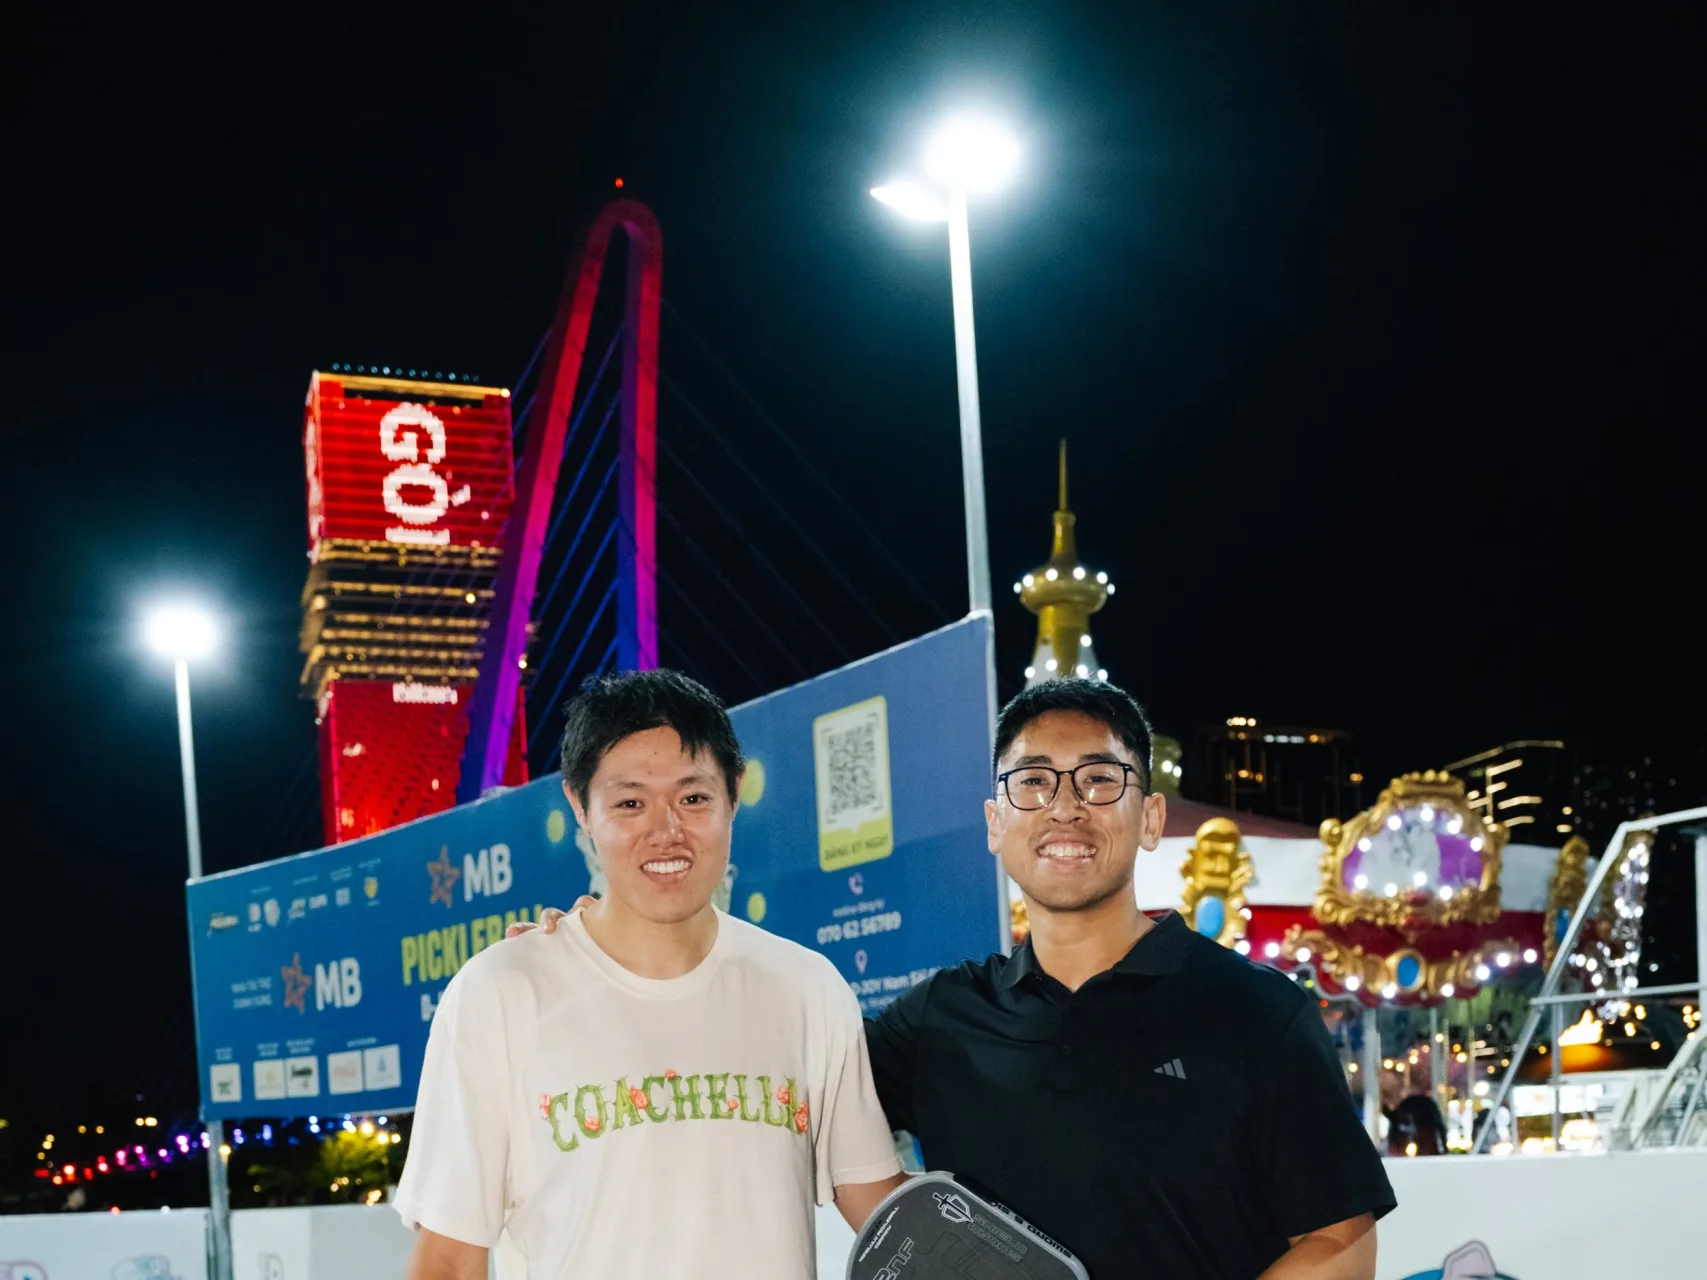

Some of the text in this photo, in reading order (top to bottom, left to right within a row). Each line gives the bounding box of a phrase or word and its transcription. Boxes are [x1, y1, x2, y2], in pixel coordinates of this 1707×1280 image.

[463, 843, 513, 902] MB
[315, 957, 363, 1011] MB
[1027, 1225, 1072, 1258] SWORD
